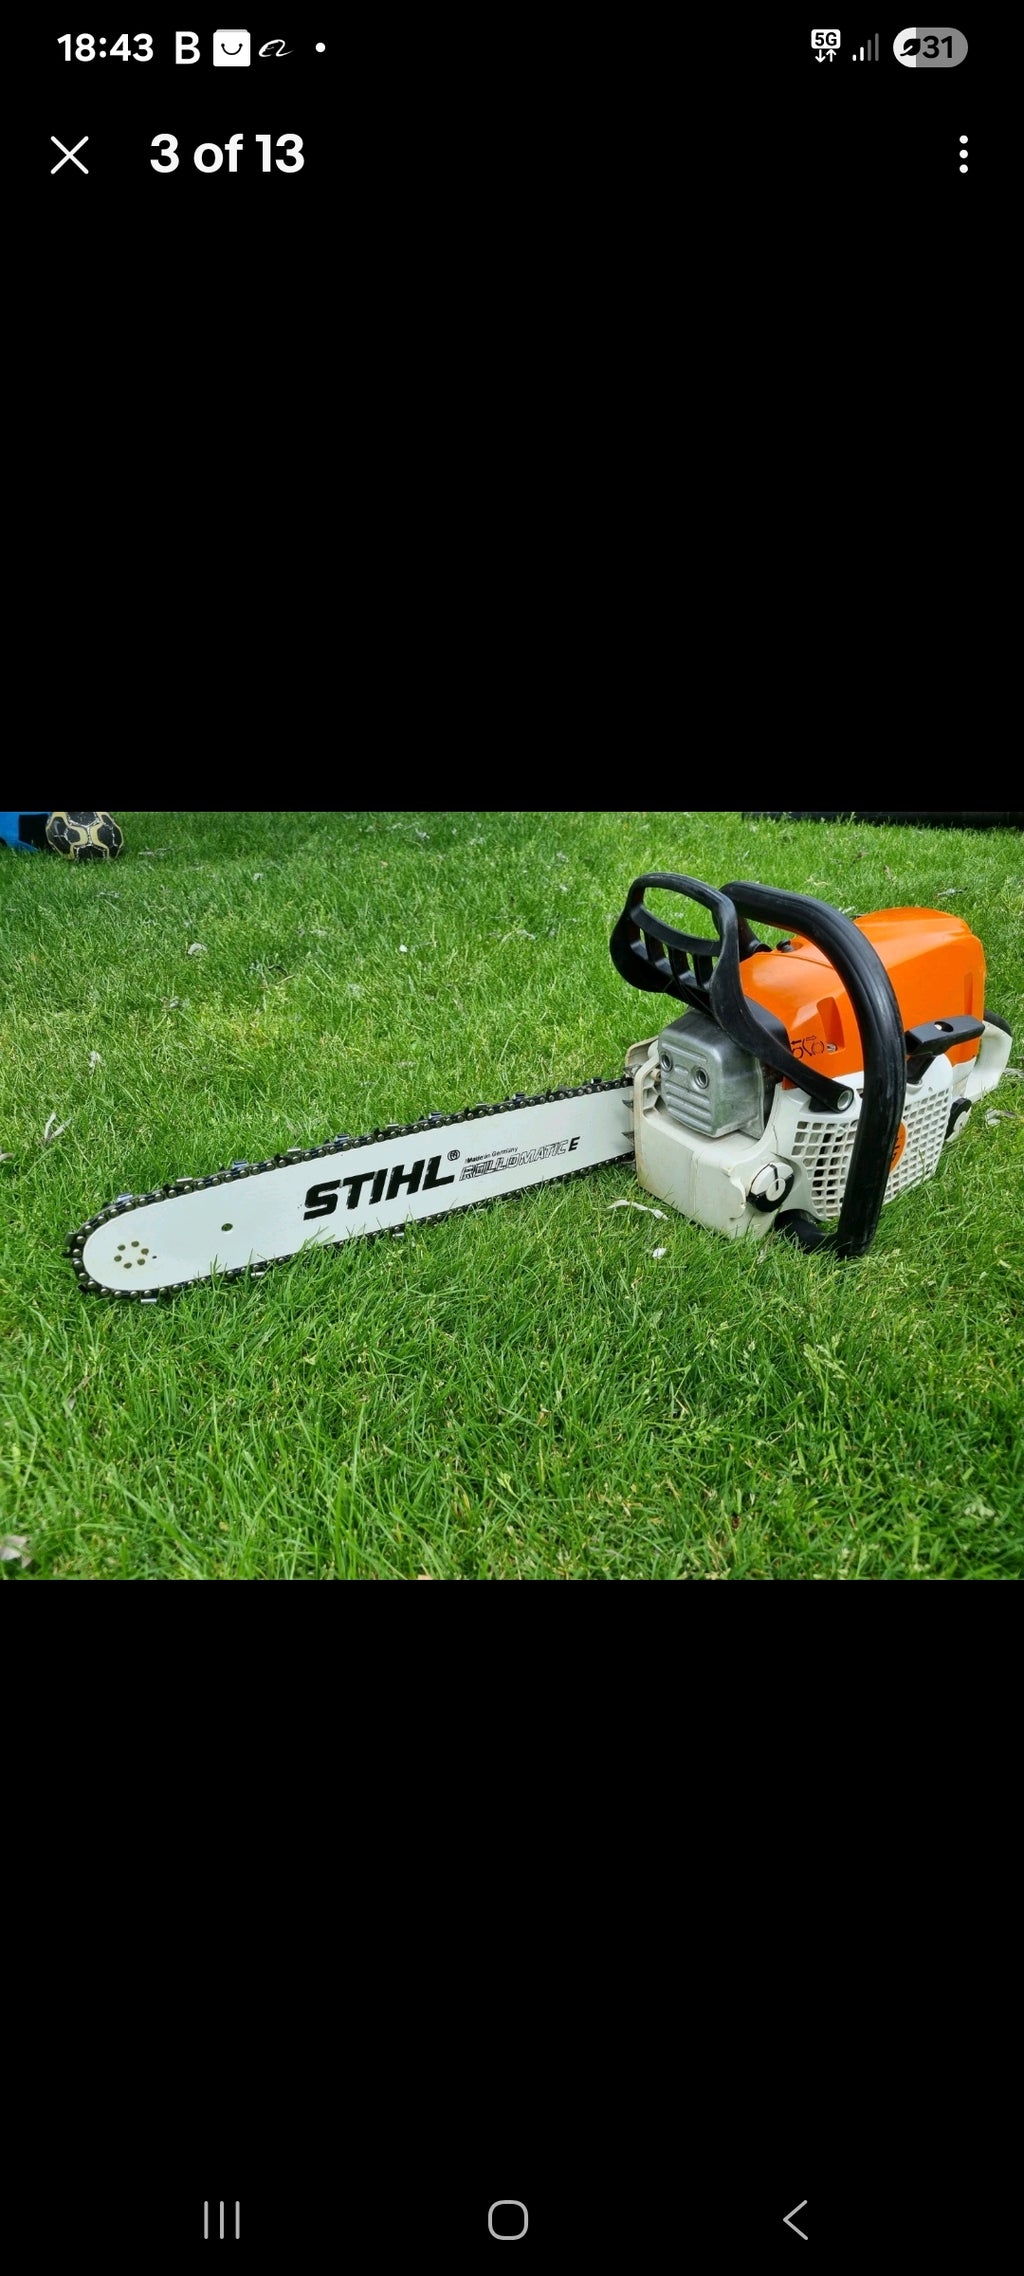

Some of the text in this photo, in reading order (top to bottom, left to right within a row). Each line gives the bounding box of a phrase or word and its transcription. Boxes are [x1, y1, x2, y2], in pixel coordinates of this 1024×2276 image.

[459, 1136, 580, 1181] ROLLOMATIC E
[466, 1155, 483, 1163] Made
[491, 1147, 518, 1158] Germany
